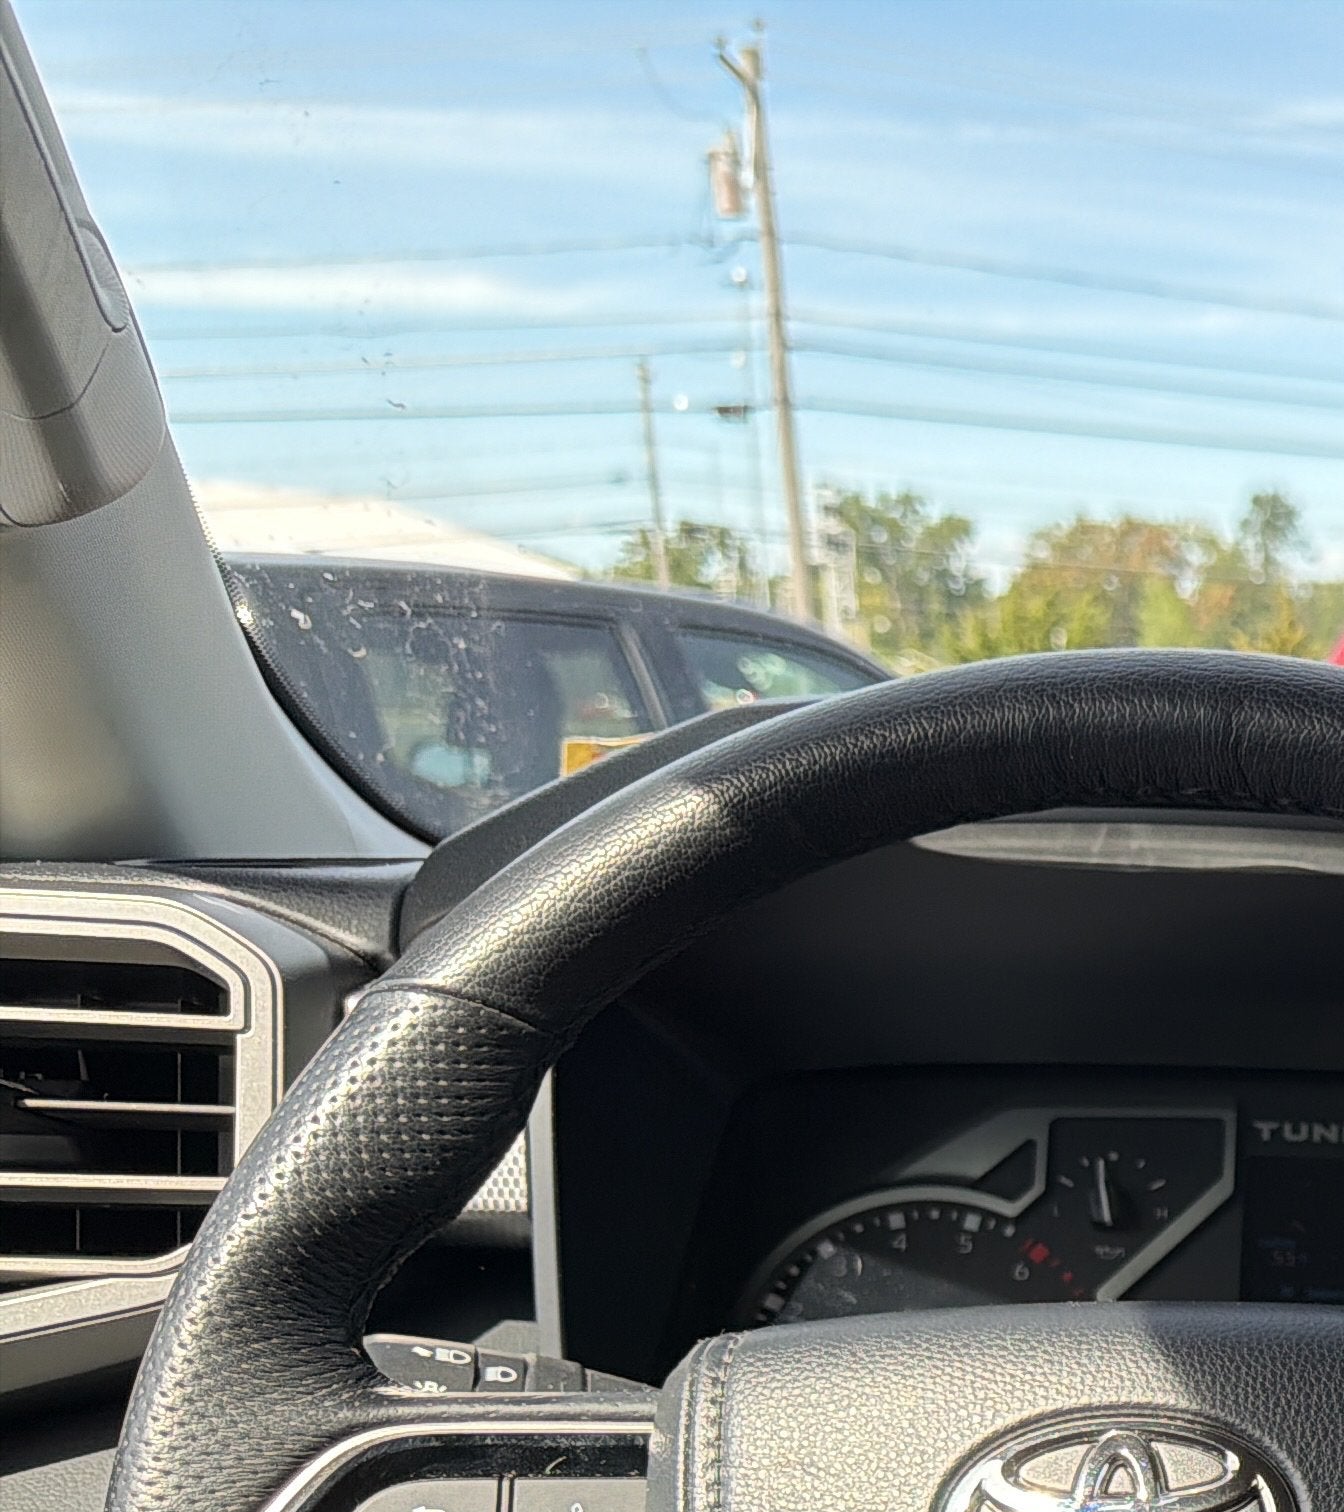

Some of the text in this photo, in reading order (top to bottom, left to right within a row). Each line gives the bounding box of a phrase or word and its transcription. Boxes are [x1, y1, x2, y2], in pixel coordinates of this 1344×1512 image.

[891, 1236, 907, 1253] 4
[957, 1234, 974, 1254] 5
[1012, 1261, 1030, 1282] 6
